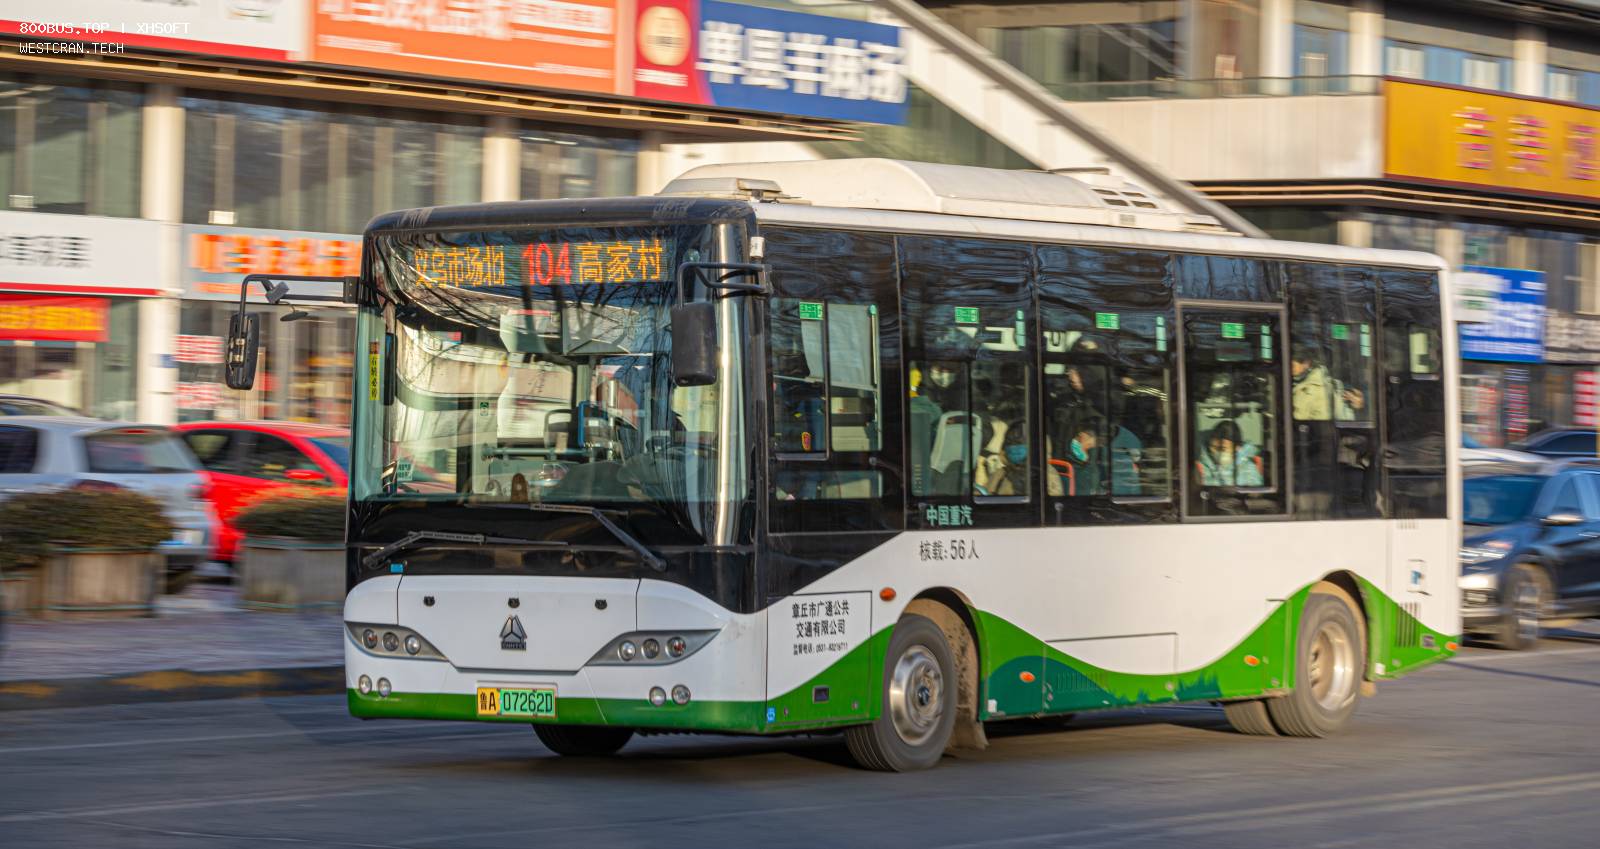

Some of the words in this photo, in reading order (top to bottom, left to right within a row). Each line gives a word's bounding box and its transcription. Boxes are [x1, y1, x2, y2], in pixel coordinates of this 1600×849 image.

[414, 245, 505, 288] 义乌市场北
[521, 241, 573, 285] 104
[576, 239, 663, 283] 高家村
[926, 504, 973, 527] 中国重汽
[792, 600, 850, 618] 章丘市广通公共
[796, 619, 846, 638] 交通有限公司
